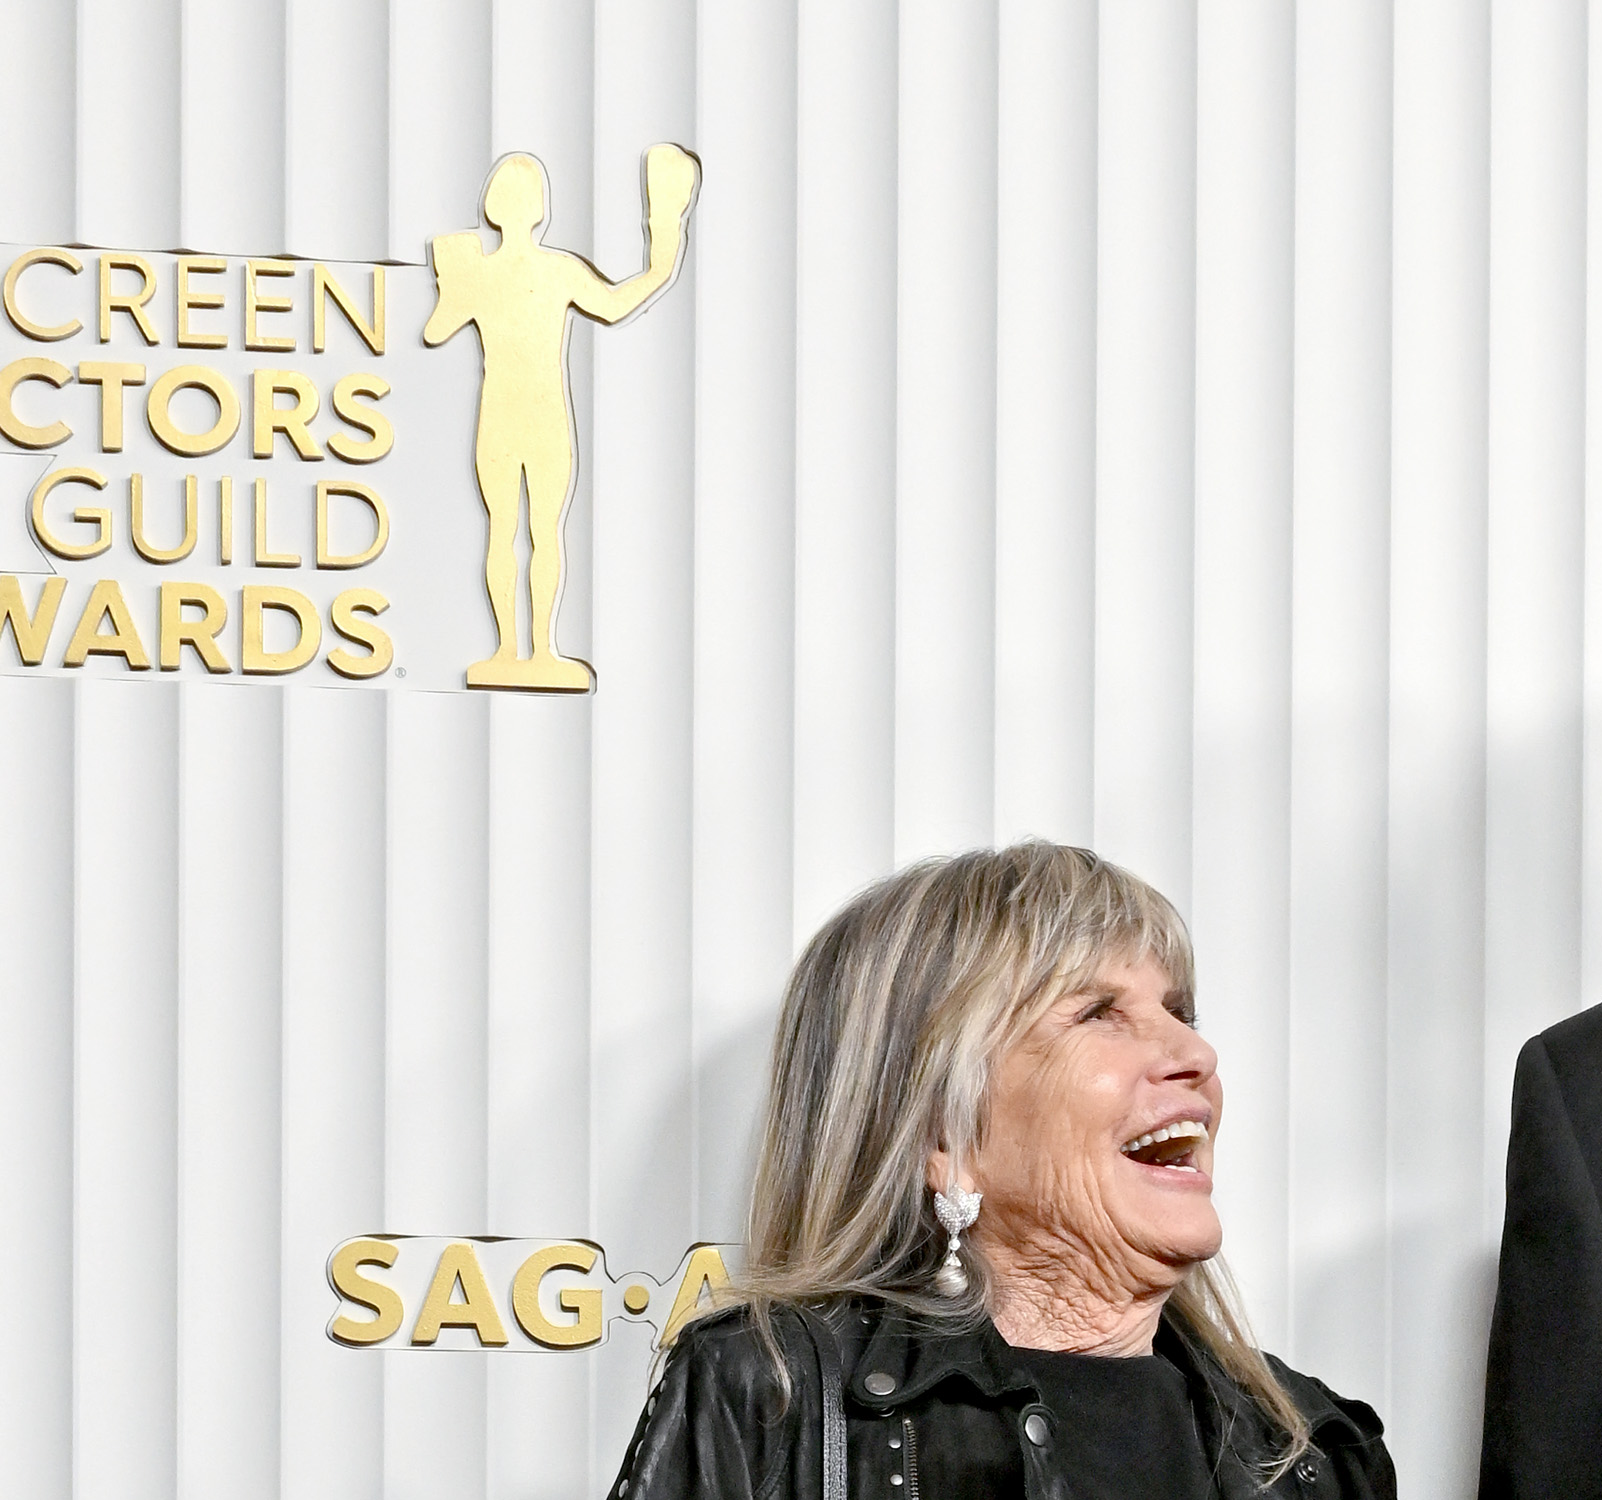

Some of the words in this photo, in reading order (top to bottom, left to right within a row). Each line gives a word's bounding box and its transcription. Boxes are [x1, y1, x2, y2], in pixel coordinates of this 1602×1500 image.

[2, 248, 386, 356] CREEN
[0, 357, 395, 464] CTORS
[31, 466, 390, 571] GUILD
